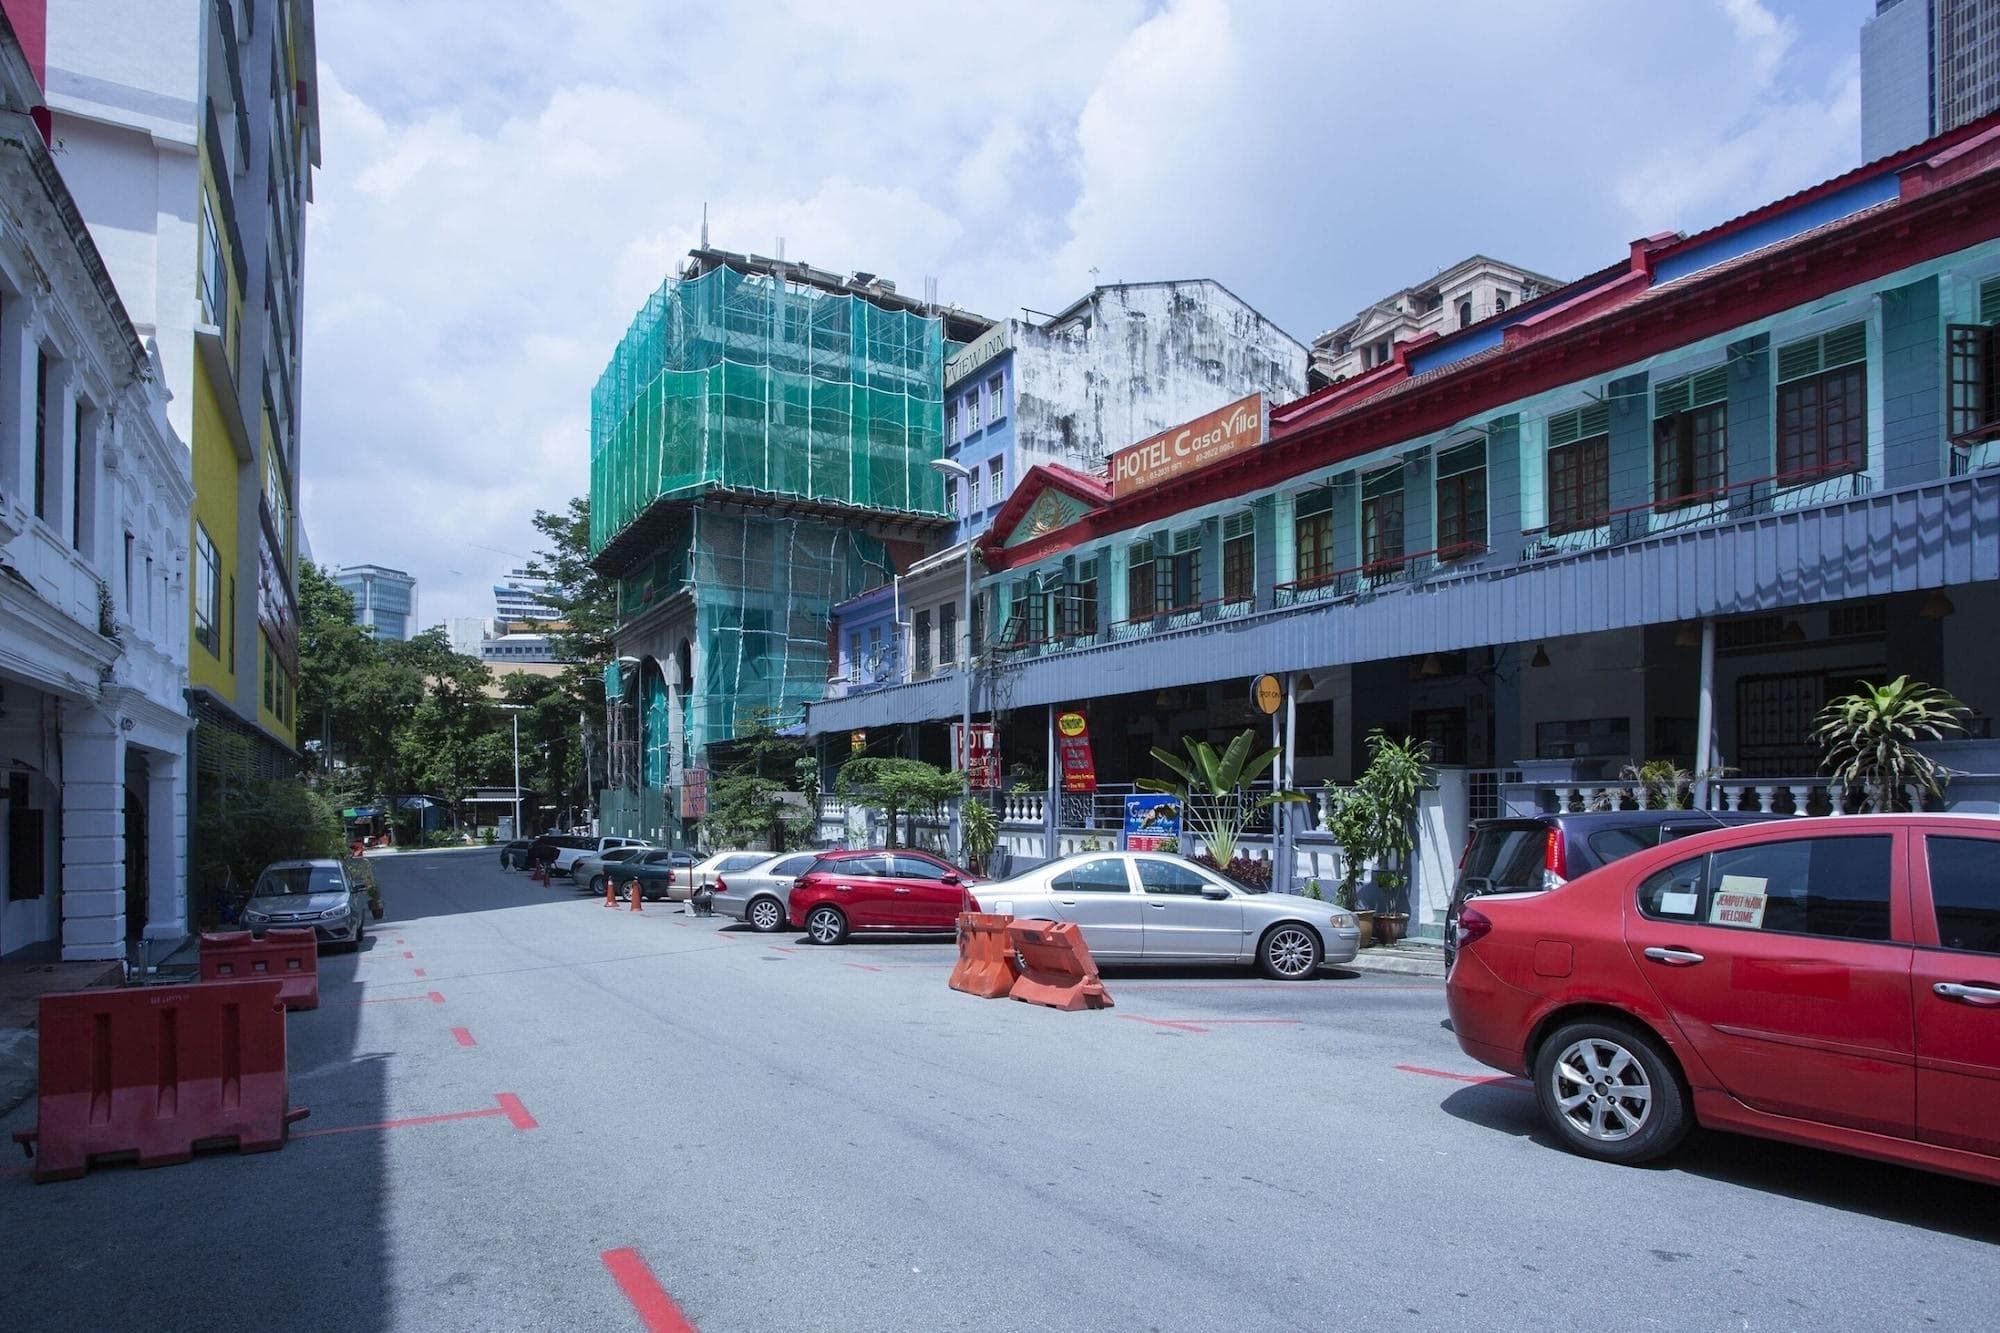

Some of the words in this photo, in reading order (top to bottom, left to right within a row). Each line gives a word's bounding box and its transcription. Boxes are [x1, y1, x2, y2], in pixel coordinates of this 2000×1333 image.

[985, 331, 1005, 360] INN
[1116, 440, 1171, 482] HOTEL
[1174, 428, 1221, 457] Casa
[1221, 406, 1258, 438] Villa
[1716, 894, 1744, 908] JEMPUT
[1720, 909, 1753, 923] WELCOME
